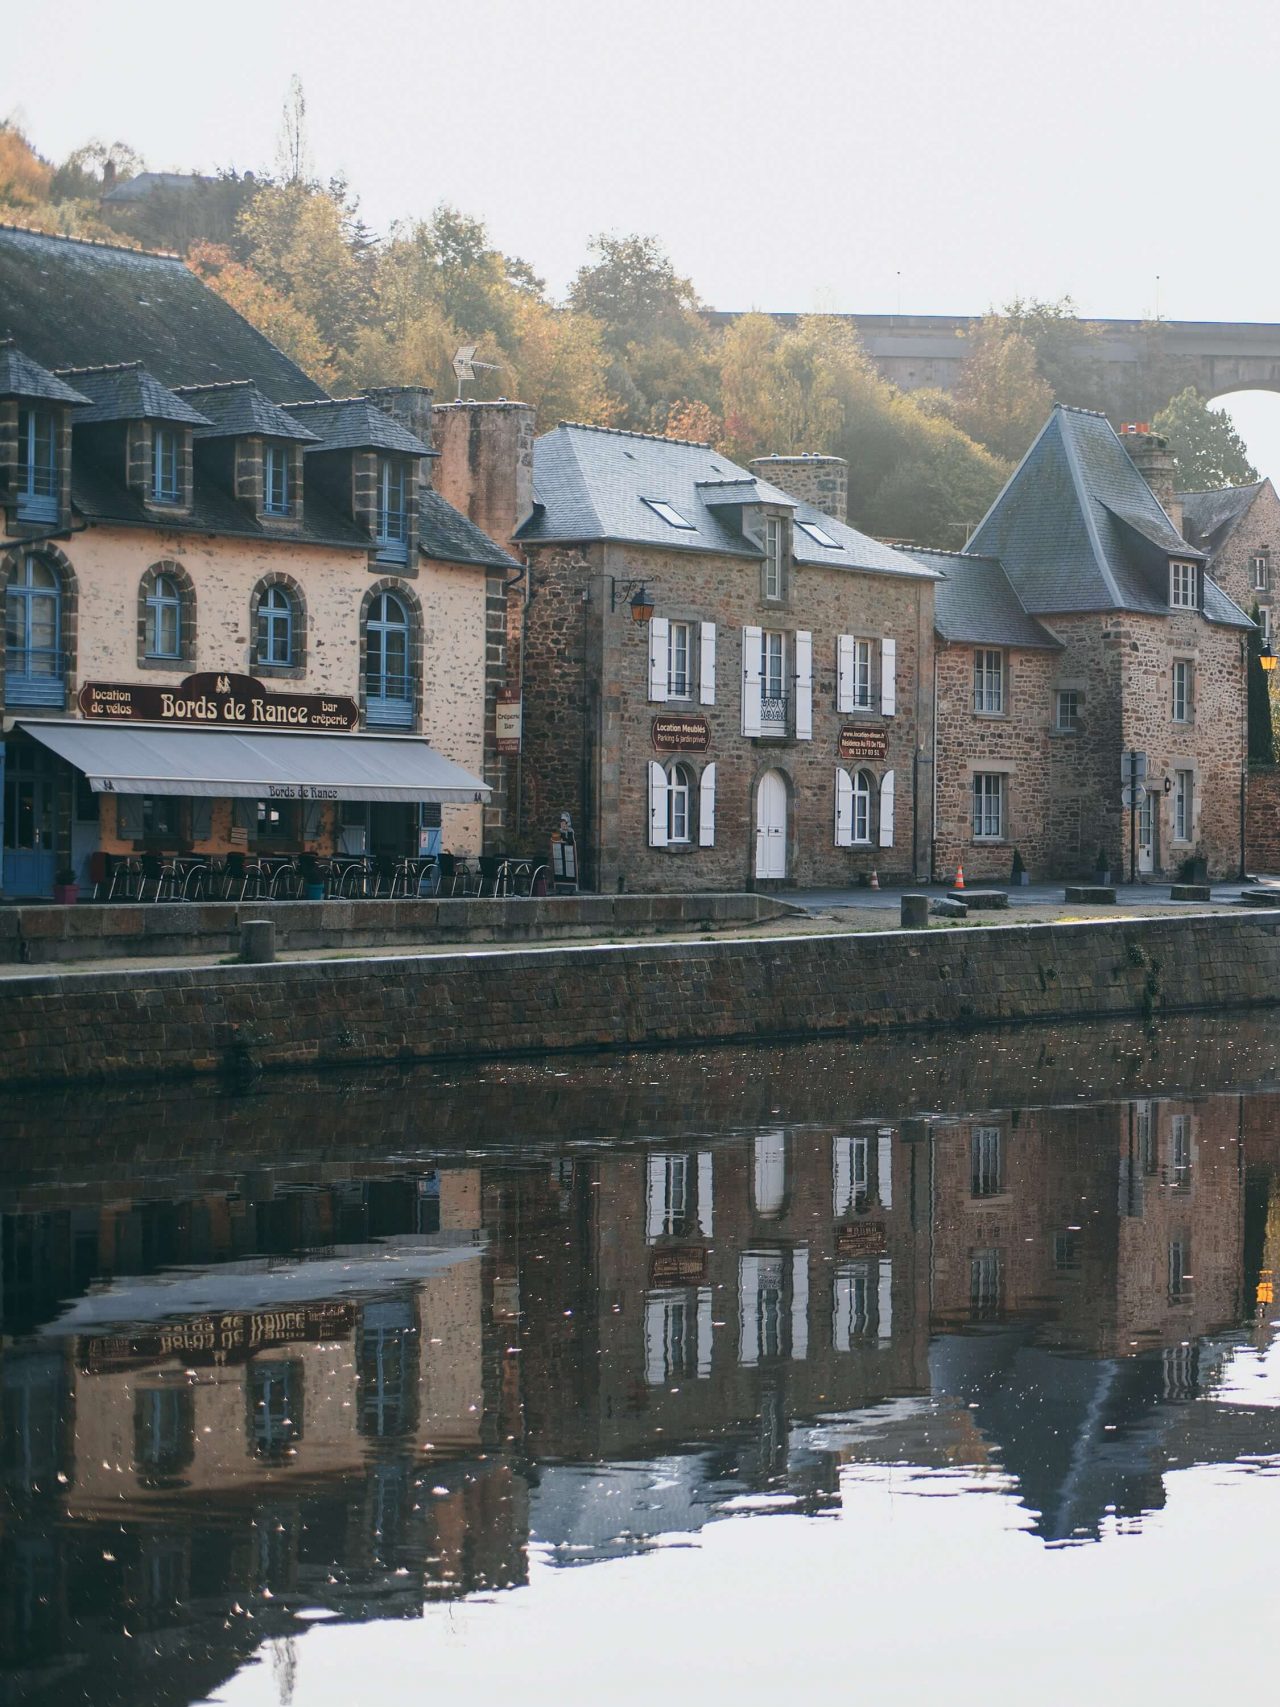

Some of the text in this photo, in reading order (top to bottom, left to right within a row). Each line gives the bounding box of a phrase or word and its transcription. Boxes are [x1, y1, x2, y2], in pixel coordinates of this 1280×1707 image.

[92, 687, 132, 702] location
[91, 702, 132, 715] de vélos
[160, 693, 308, 724] Bords de Rance
[321, 700, 338, 713] bar
[311, 713, 348, 727] crêperie
[657, 723, 705, 733] Location Meublés
[657, 733, 674, 743] Parking
[675, 734, 680, 743] &
[268, 785, 338, 799] Bords de Rance
